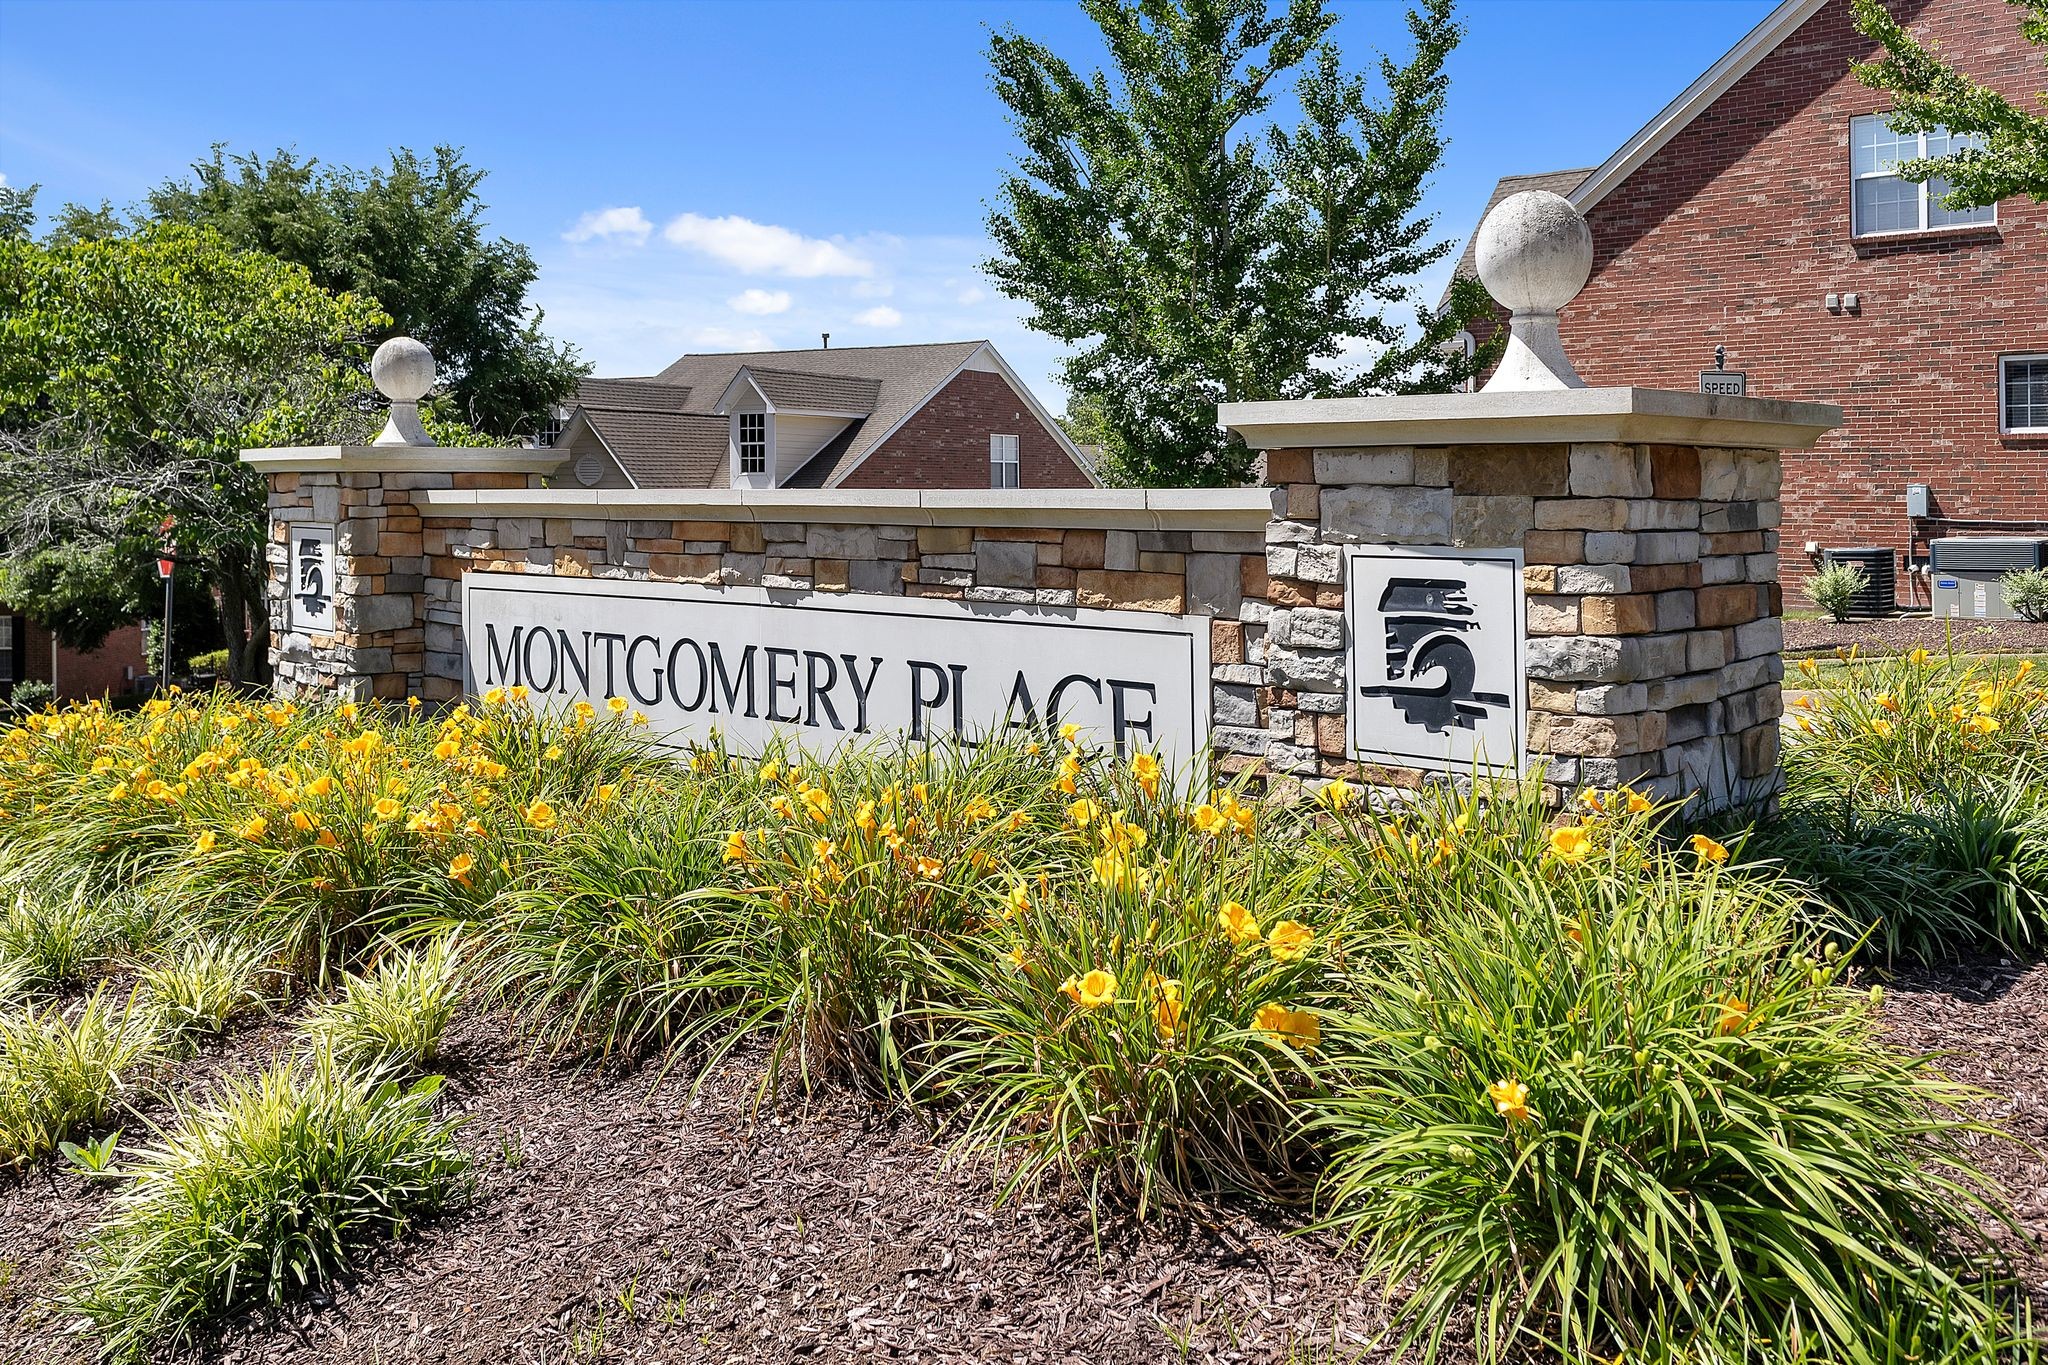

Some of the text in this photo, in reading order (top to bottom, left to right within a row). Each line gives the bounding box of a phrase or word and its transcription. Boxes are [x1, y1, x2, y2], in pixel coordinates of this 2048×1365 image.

[1704, 382, 1740, 395] SPEED
[485, 623, 1158, 766] MONTGOMERY PLACE
